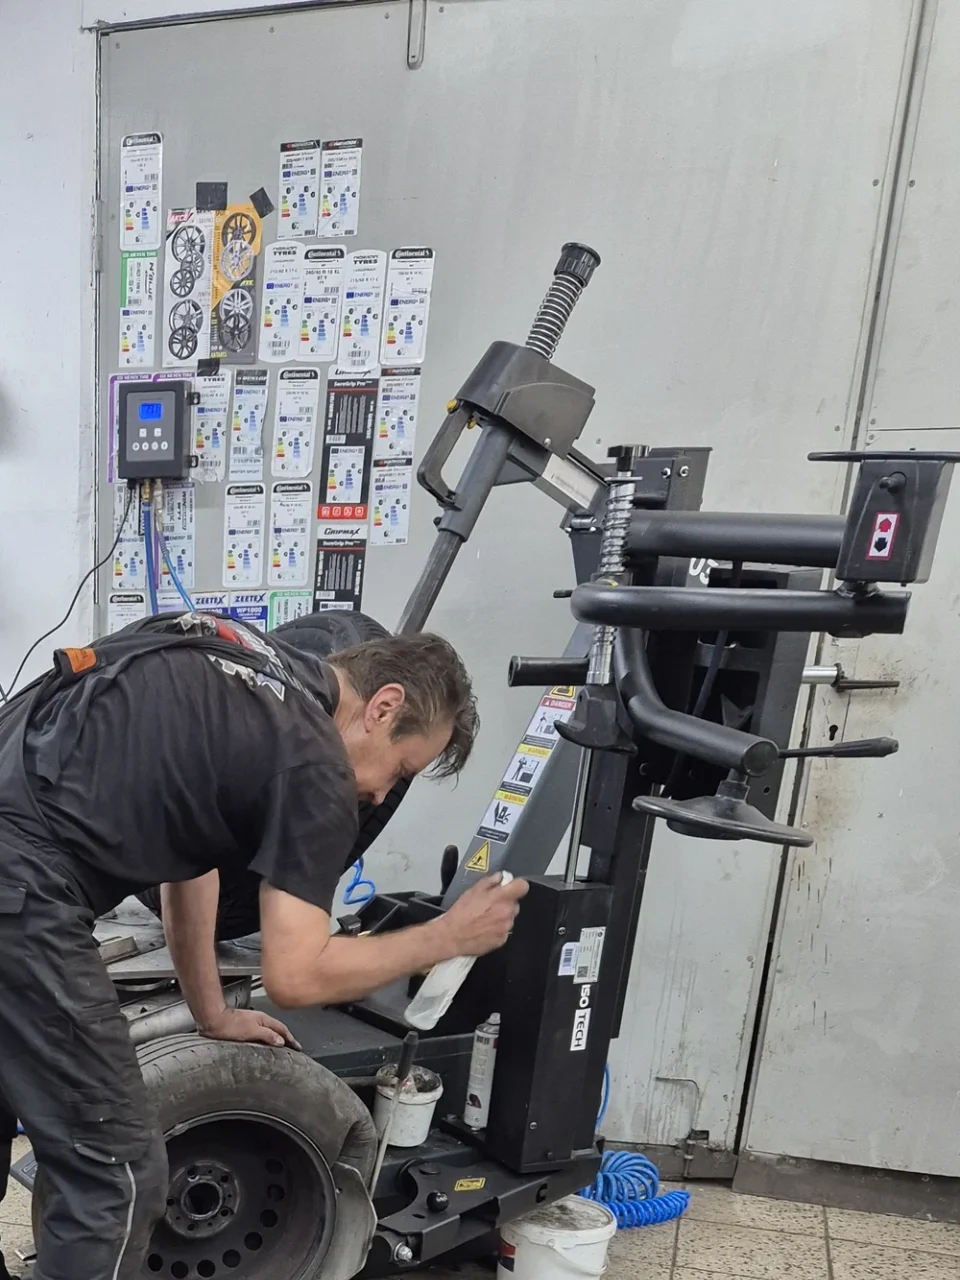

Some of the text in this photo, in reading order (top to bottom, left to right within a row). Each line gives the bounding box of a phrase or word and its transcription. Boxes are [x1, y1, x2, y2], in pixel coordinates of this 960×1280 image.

[308, 250, 336, 259] Continental
[395, 250, 425, 258] Continental
[195, 594, 227, 605] ZEETEX
[235, 592, 266, 603] ZEETEX
